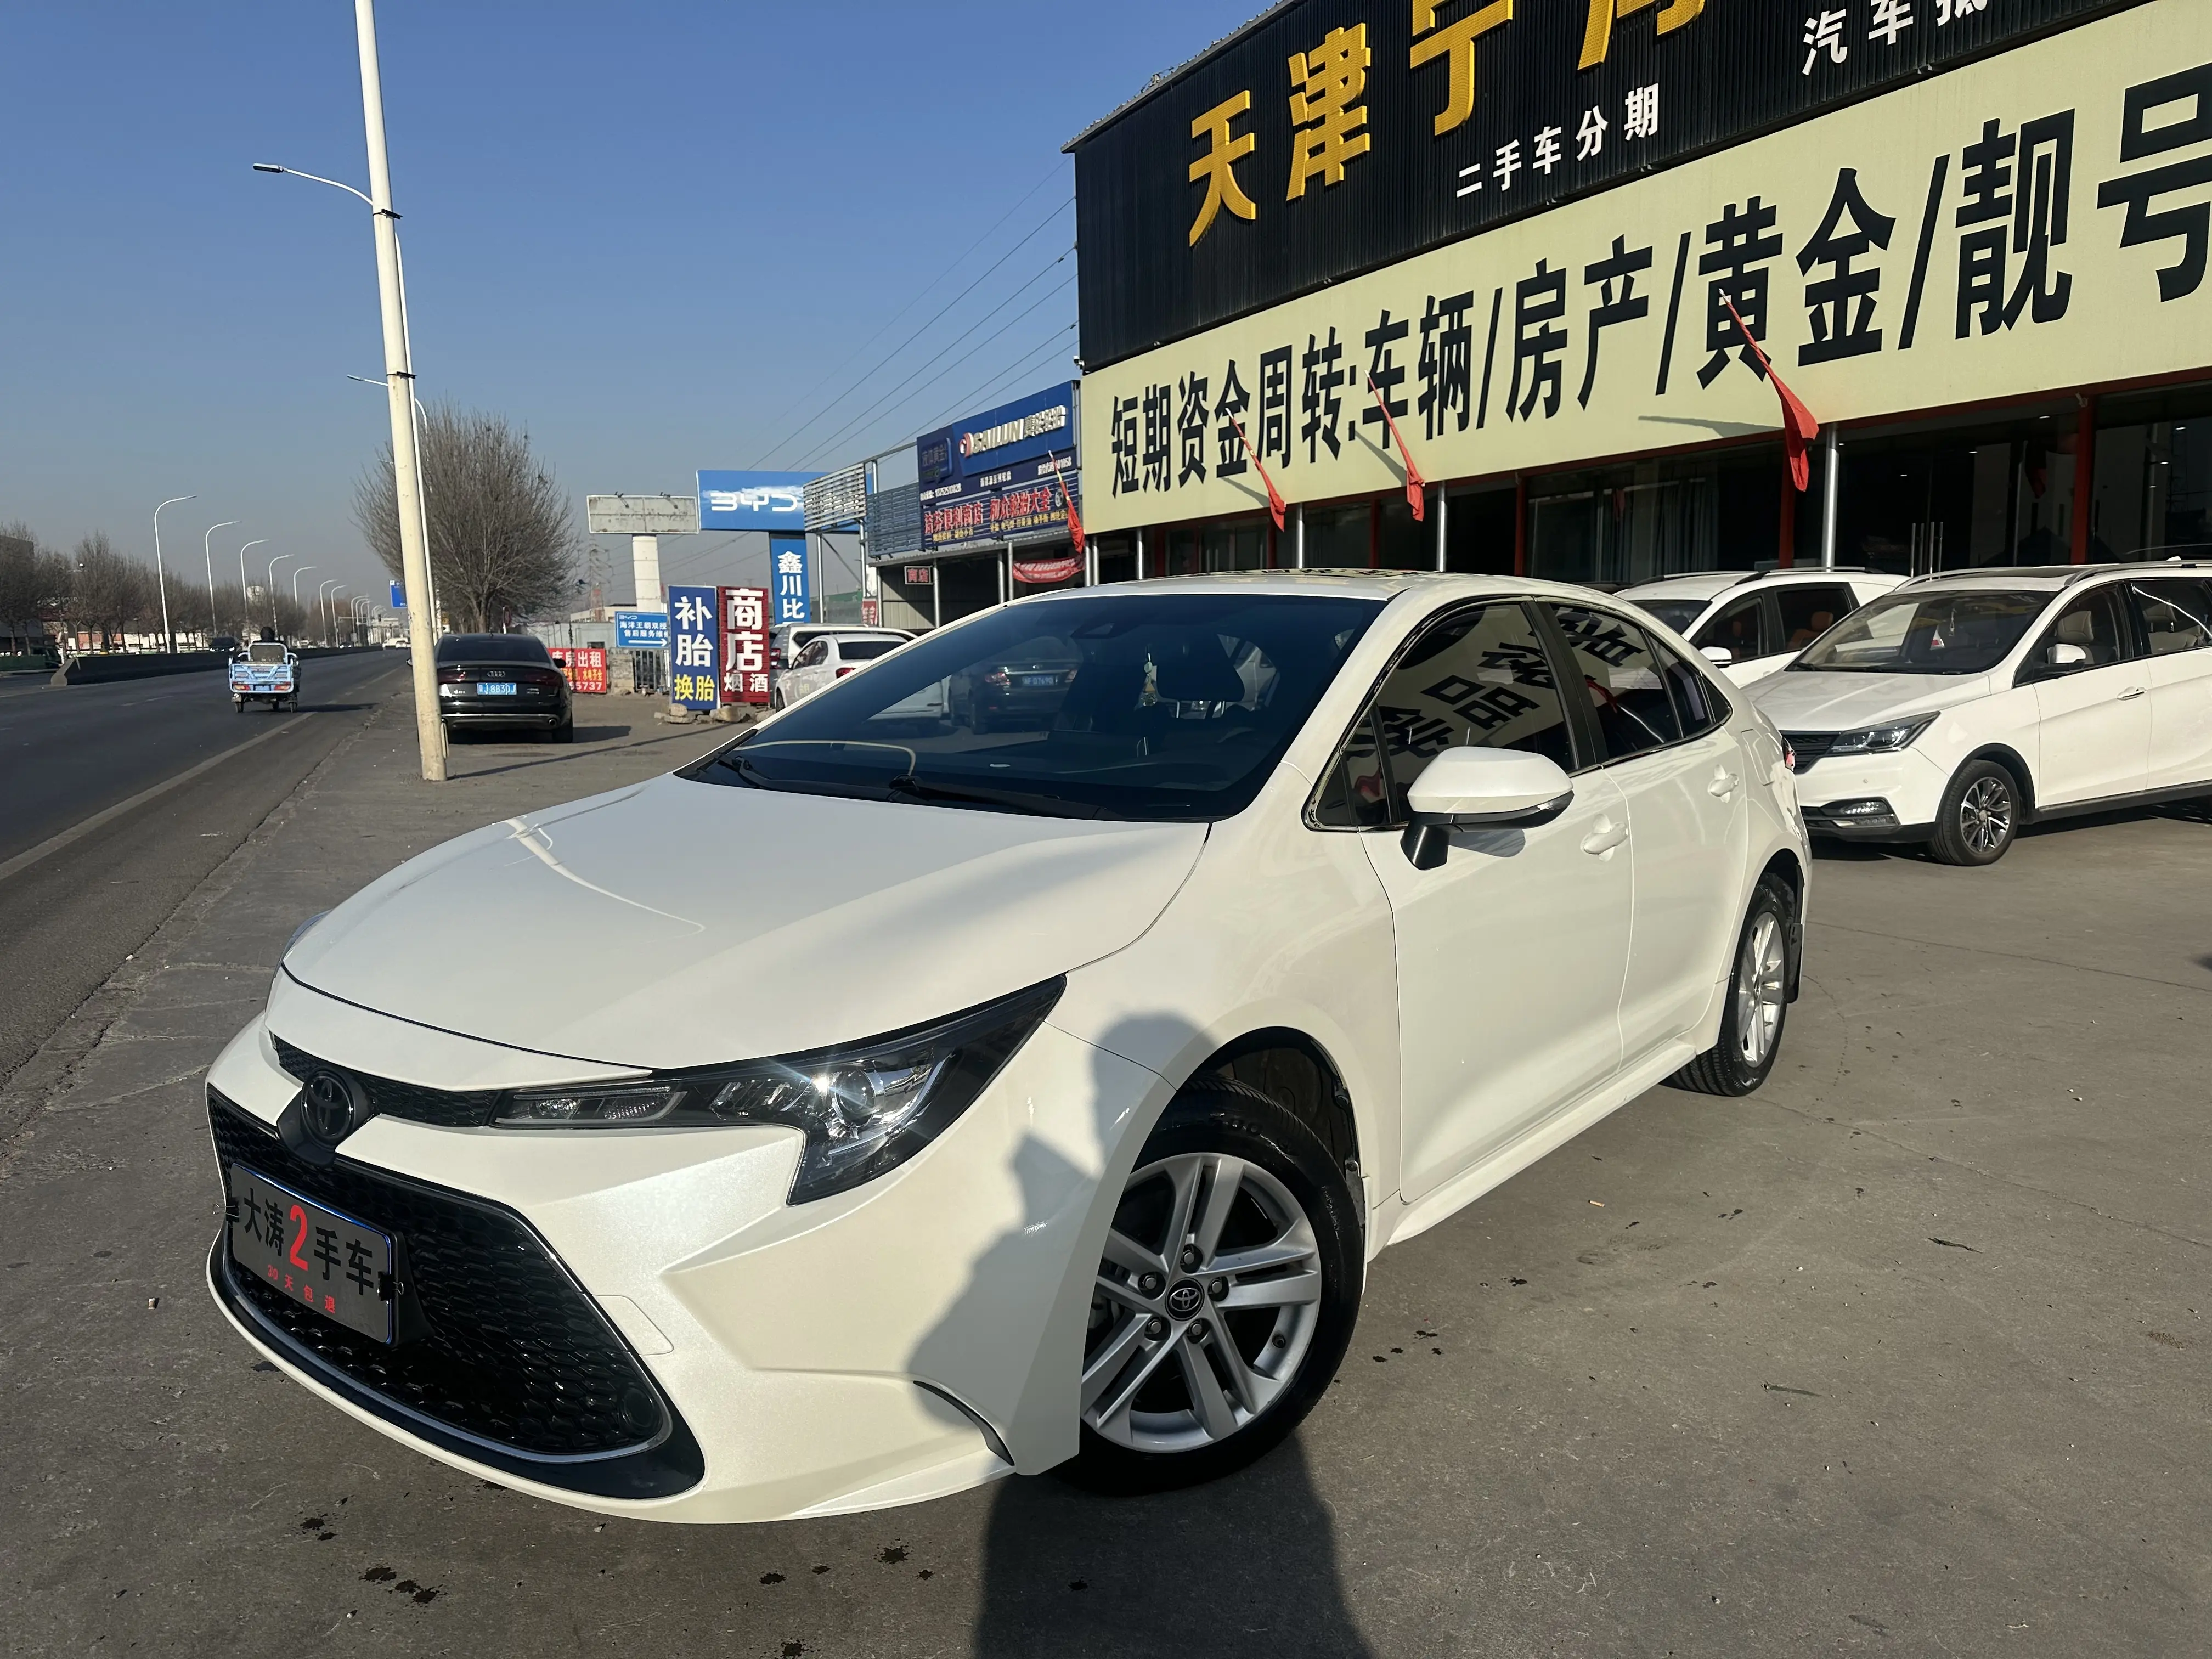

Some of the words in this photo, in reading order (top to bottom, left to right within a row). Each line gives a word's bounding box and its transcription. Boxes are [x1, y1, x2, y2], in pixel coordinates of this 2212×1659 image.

[1457, 83, 1659, 198] 二手车分期
[972, 418, 1024, 454] SAILUN
[710, 493, 798, 512] BYD
[777, 551, 805, 624] 鑫川比
[674, 596, 713, 667] 补胎
[725, 588, 764, 672] 商店
[674, 674, 715, 701] 换胎
[724, 672, 768, 692] 烟酒
[244, 1187, 374, 1296] 大涛2手车
